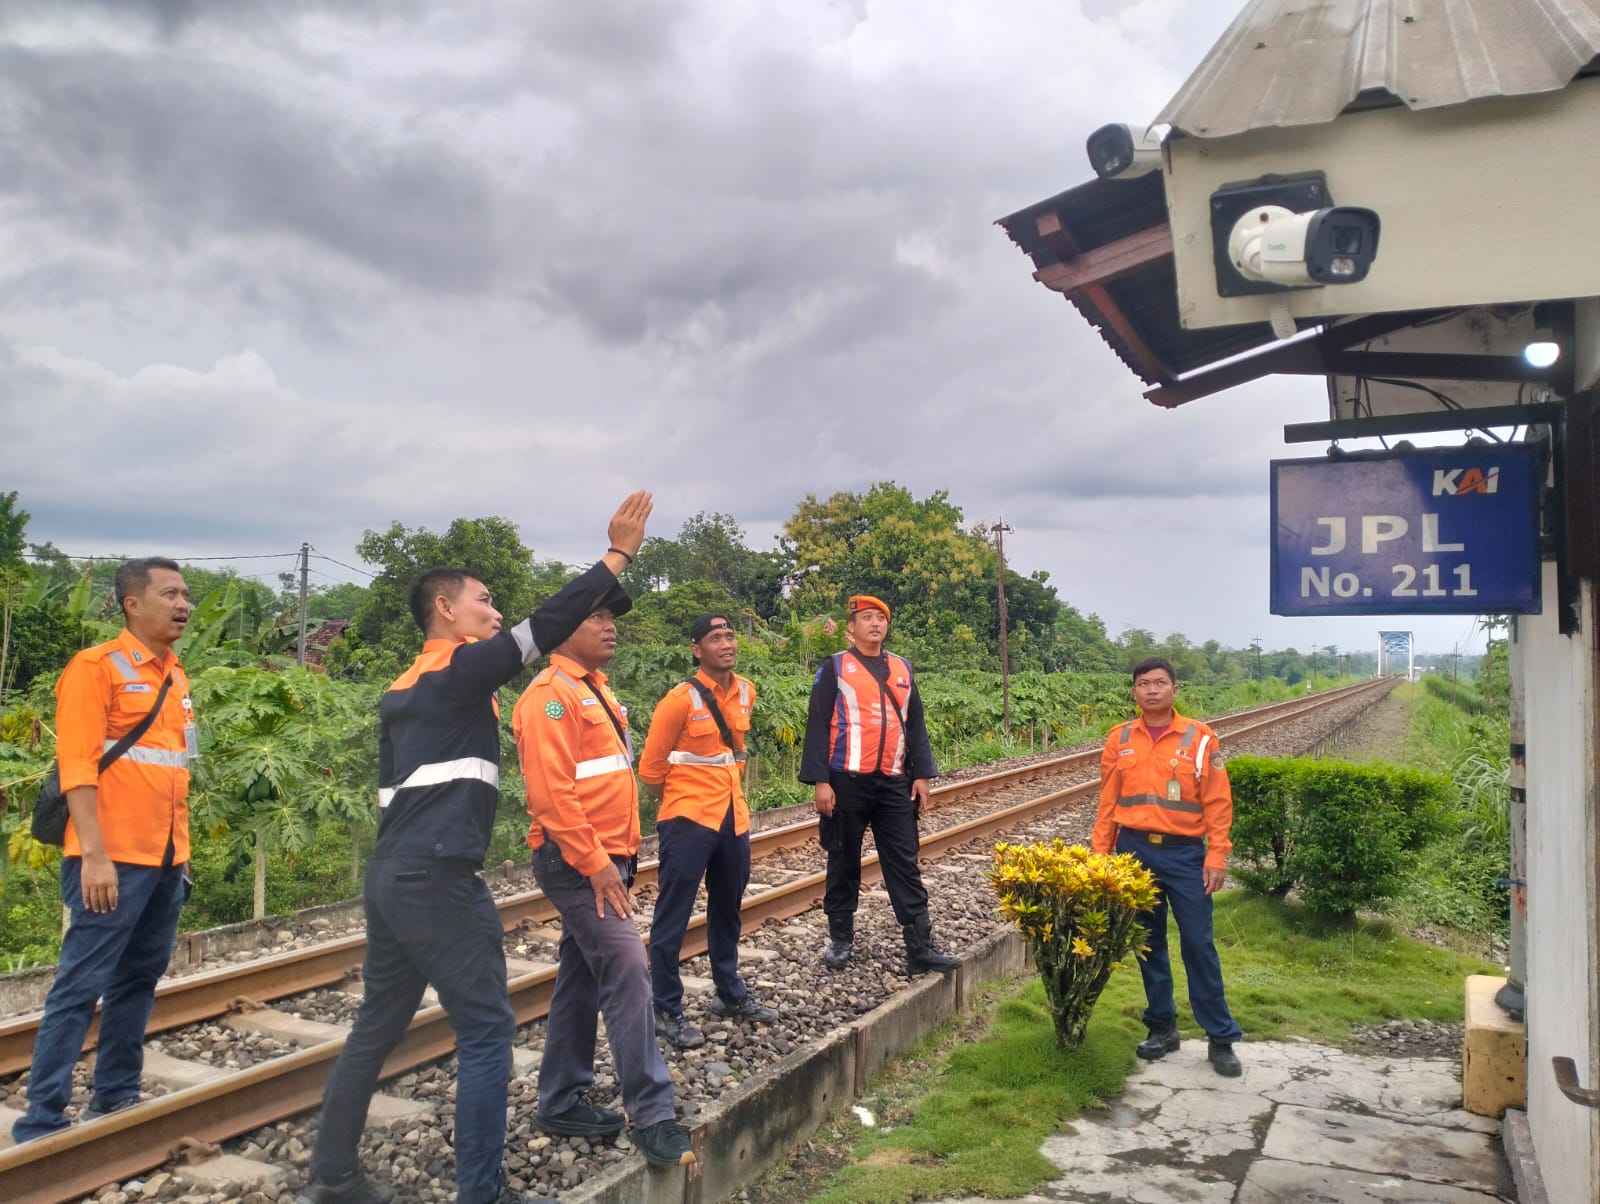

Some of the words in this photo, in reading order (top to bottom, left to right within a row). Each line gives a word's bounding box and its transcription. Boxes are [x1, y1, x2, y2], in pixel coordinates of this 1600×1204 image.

[1432, 466, 1499, 496] KAI
[1311, 513, 1465, 556] JPL
[1301, 566, 1373, 597] No.
[1391, 564, 1478, 597] 211
